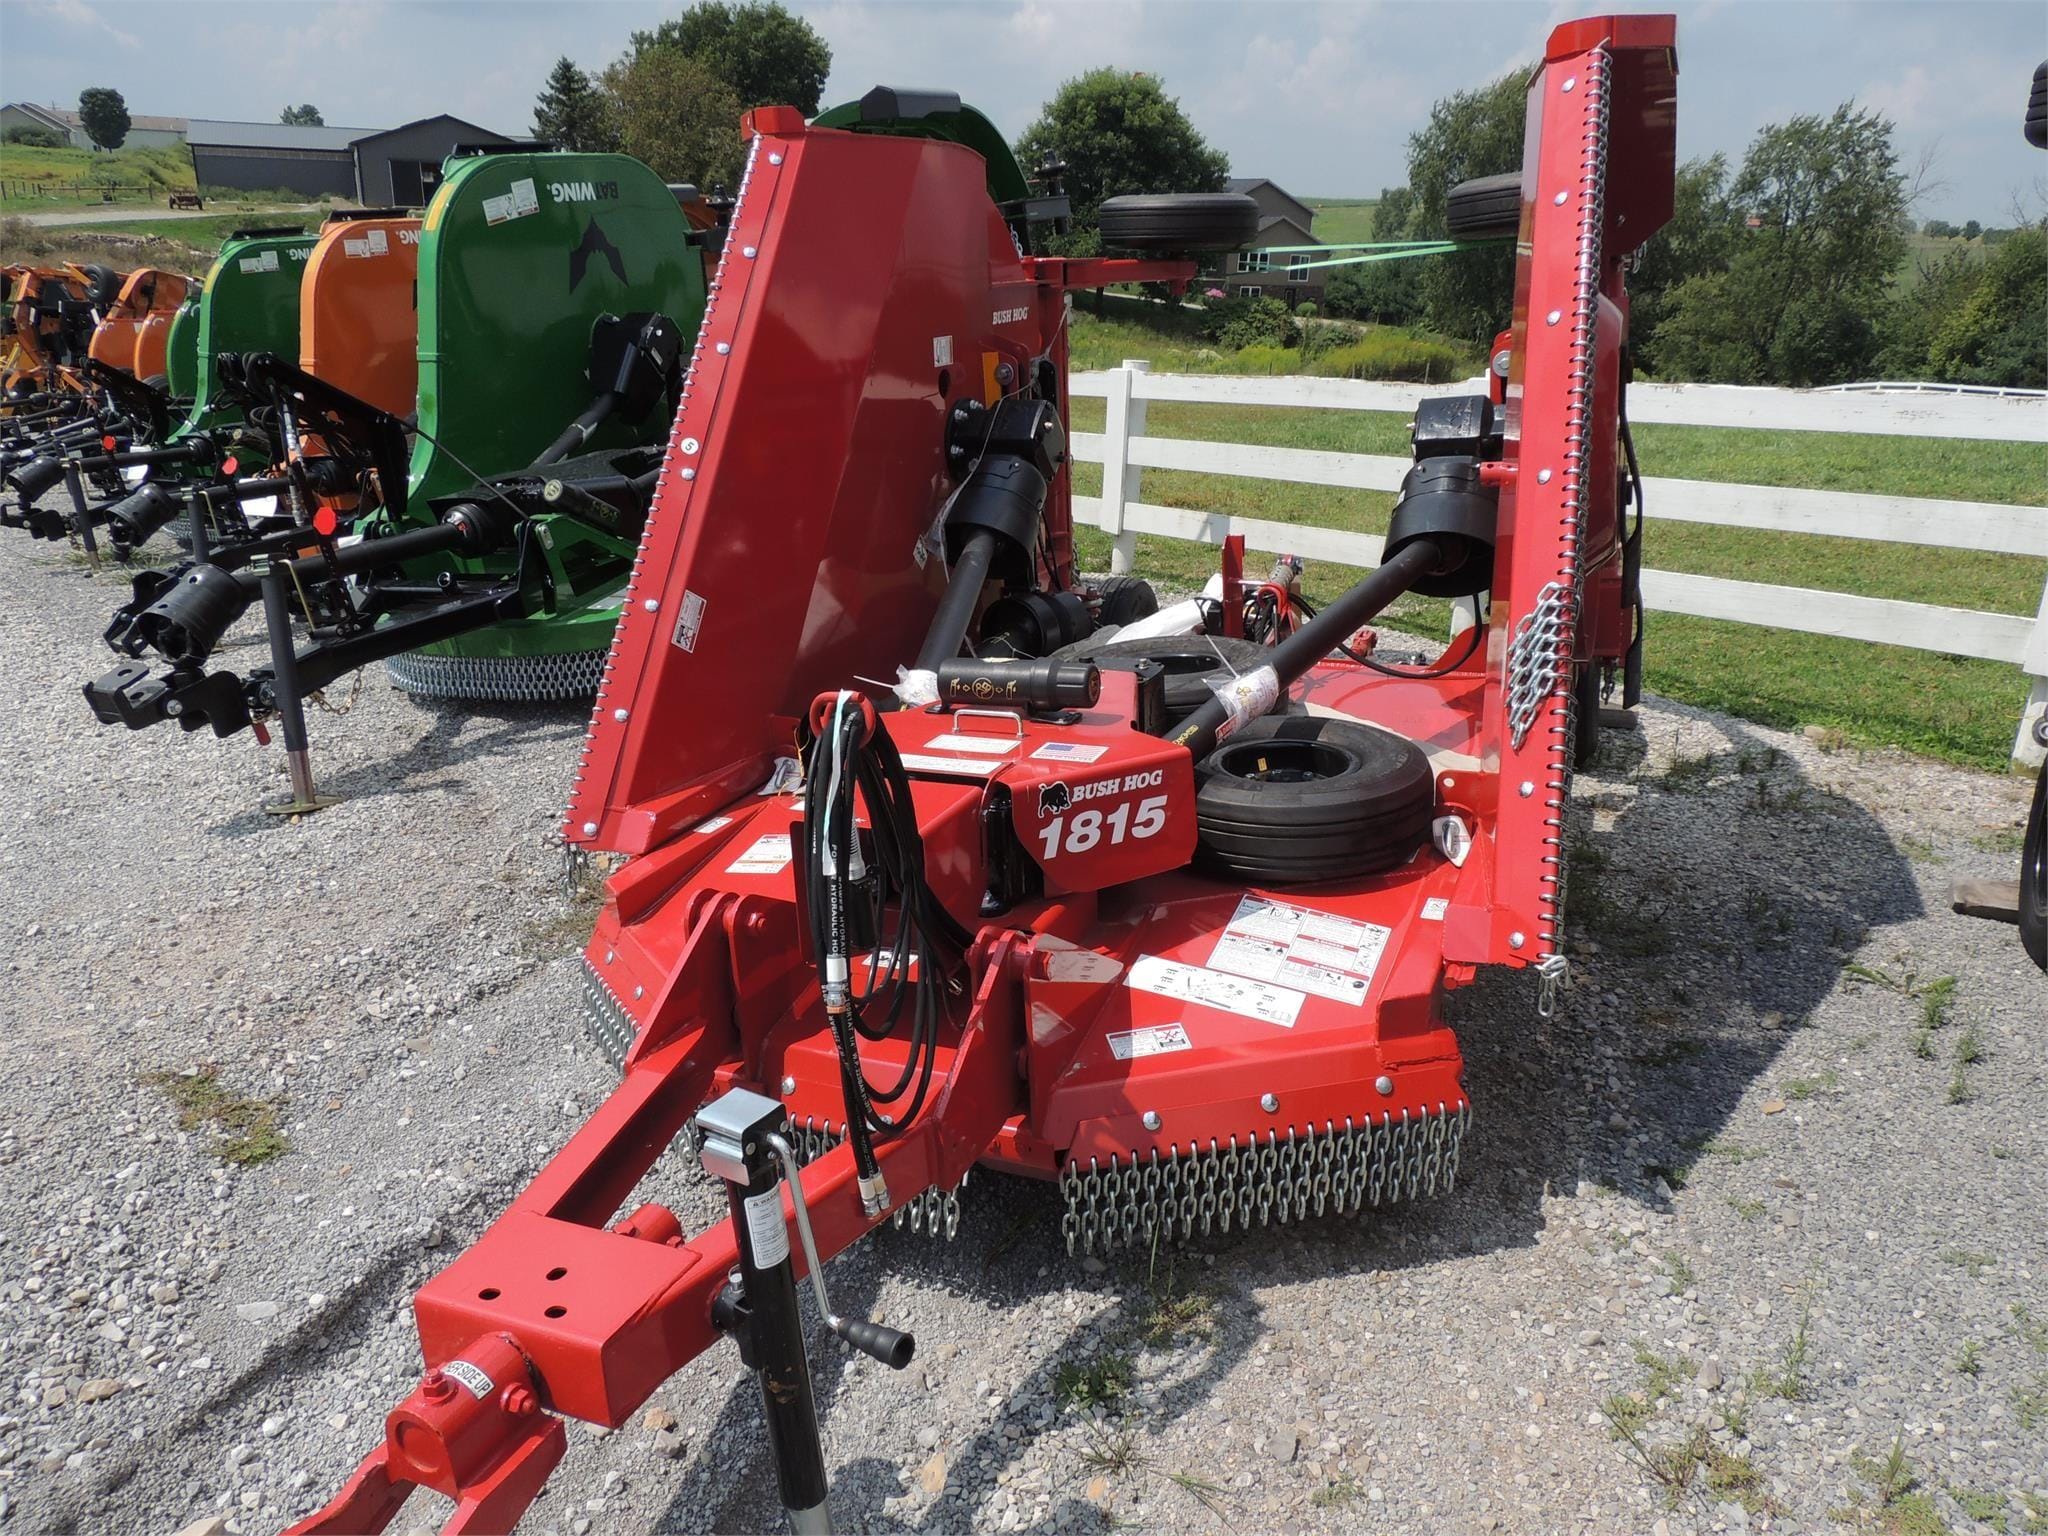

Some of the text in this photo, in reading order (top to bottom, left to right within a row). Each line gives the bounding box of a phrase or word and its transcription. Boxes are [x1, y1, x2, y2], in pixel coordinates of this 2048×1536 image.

[992, 306, 1028, 325] BUSH HOG
[684, 441, 694, 451] 5
[1072, 769, 1163, 802] BUSH HOG
[1038, 794, 1168, 860] 1815
[457, 1365, 481, 1385] SIDE
[474, 1378, 491, 1393] UP
